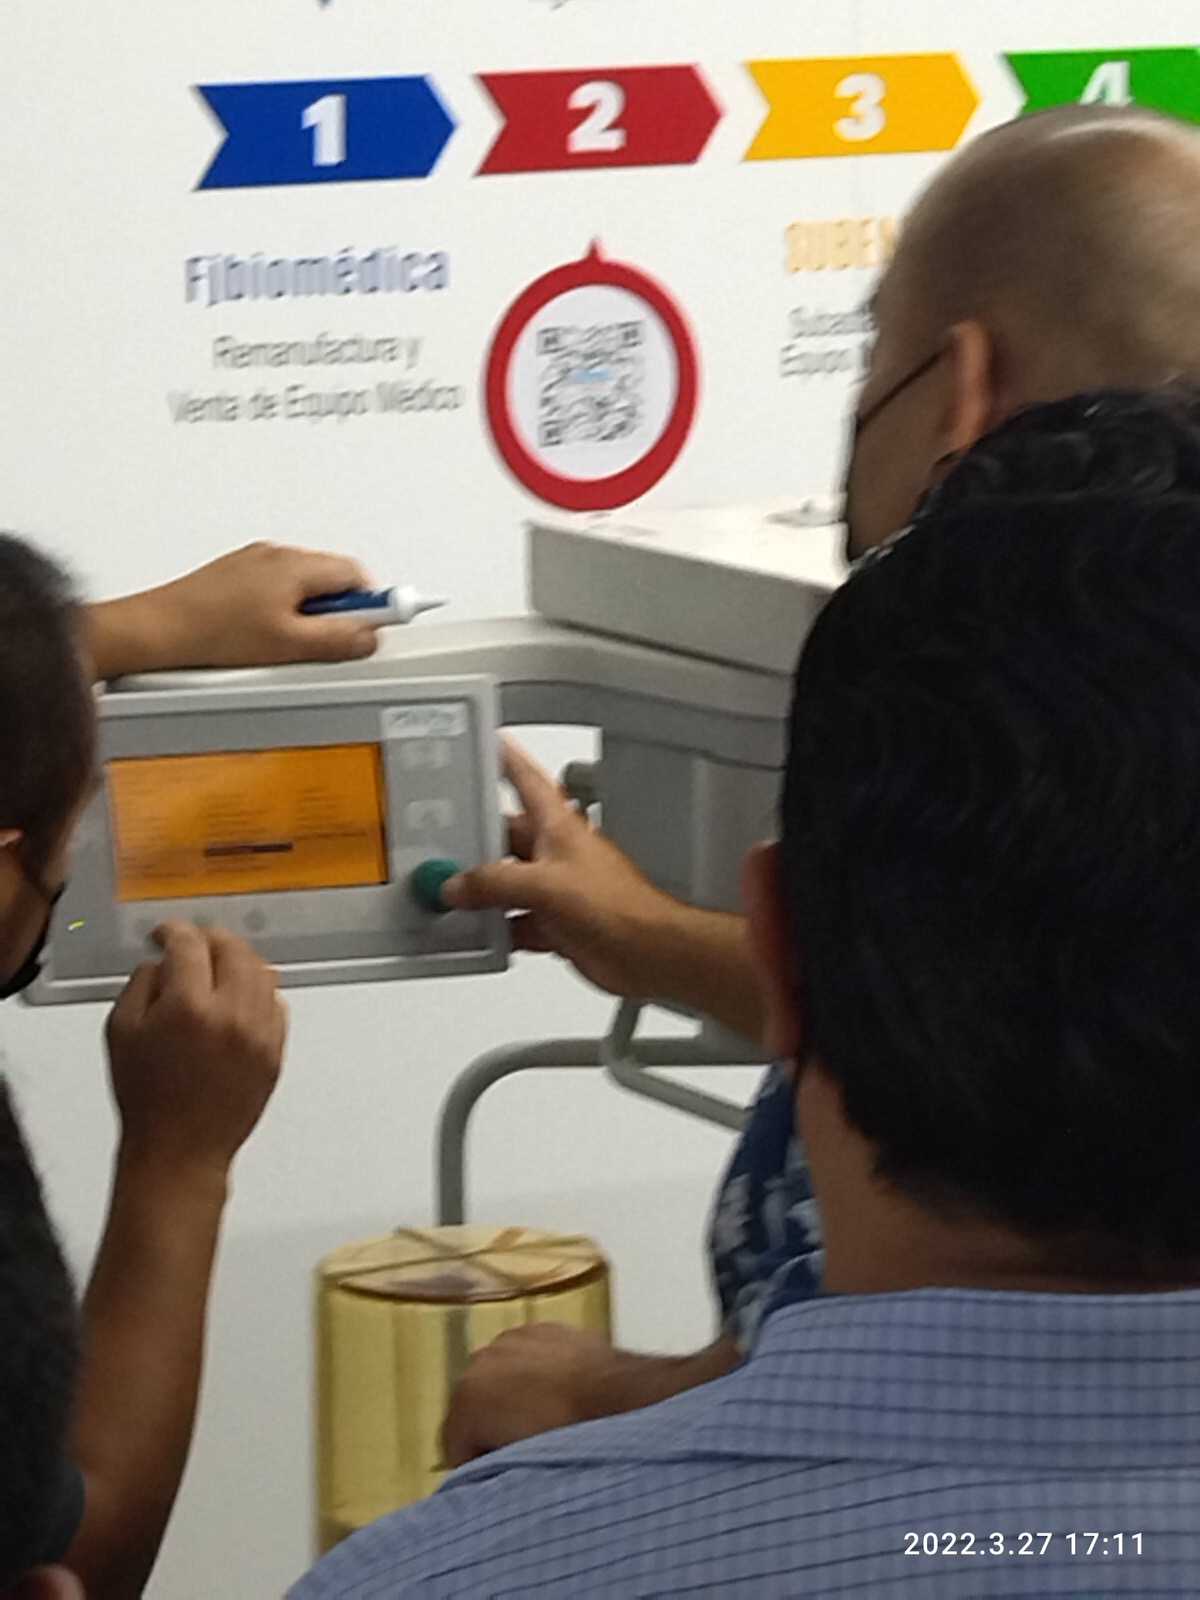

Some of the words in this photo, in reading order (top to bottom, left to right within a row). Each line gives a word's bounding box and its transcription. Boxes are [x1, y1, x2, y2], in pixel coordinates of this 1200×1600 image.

[302, 94, 346, 166] 1
[567, 81, 626, 153] 2
[833, 73, 886, 142] 3
